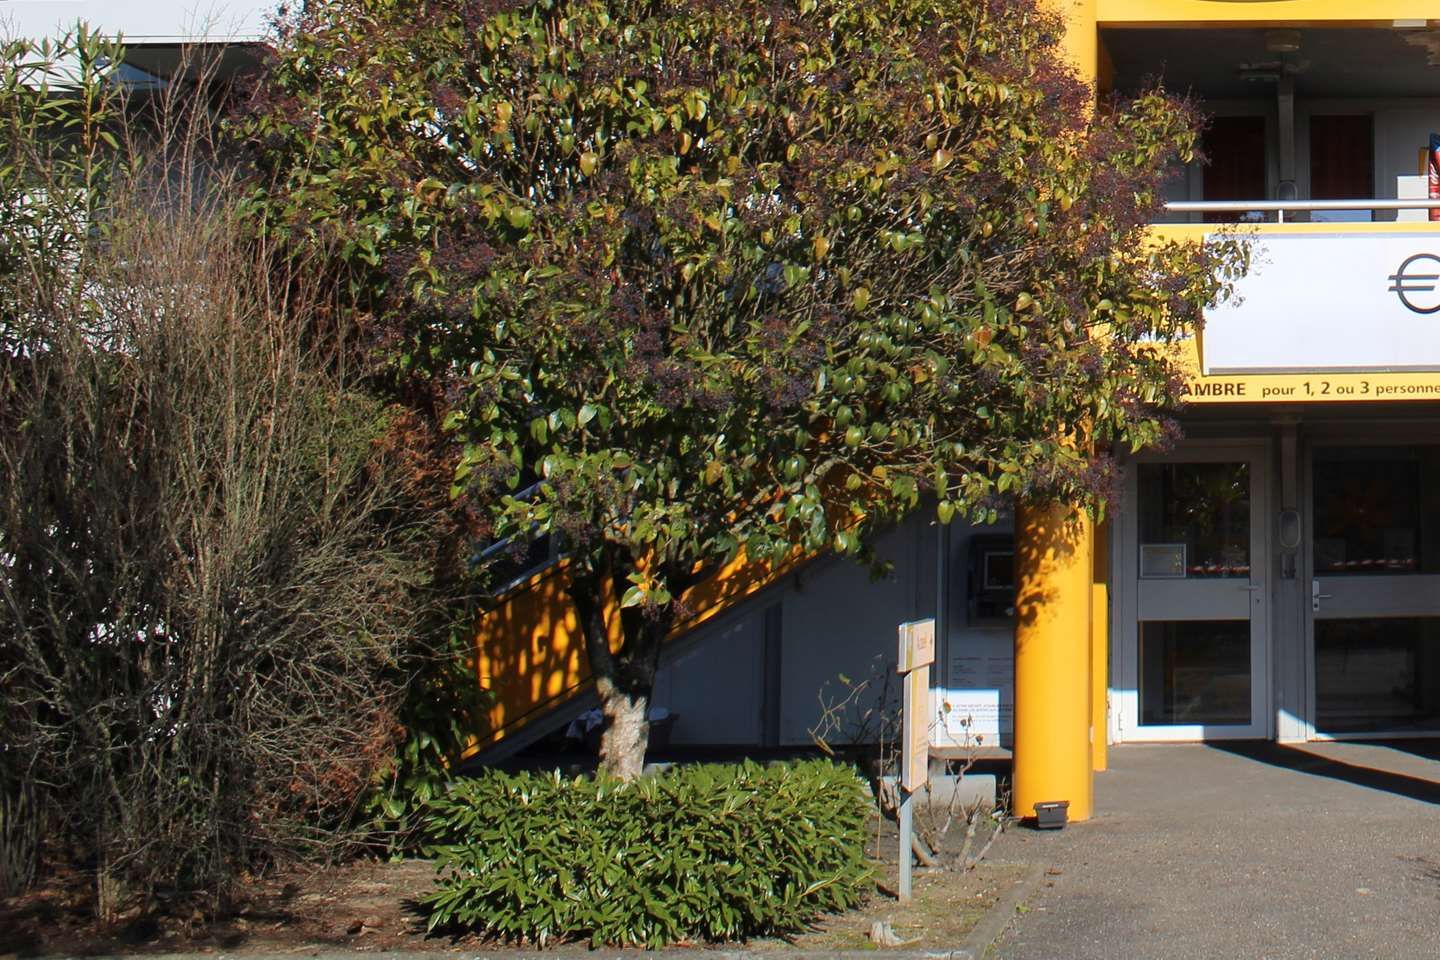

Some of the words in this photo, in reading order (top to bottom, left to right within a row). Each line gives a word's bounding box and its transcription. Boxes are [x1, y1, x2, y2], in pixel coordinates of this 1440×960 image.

[1179, 382, 1247, 397] AMBRE
[1262, 386, 1297, 398] pour
[1303, 381, 1315, 397] 1,
[1320, 381, 1331, 395] 2
[1336, 386, 1355, 395] ou
[1360, 381, 1370, 395] 3
